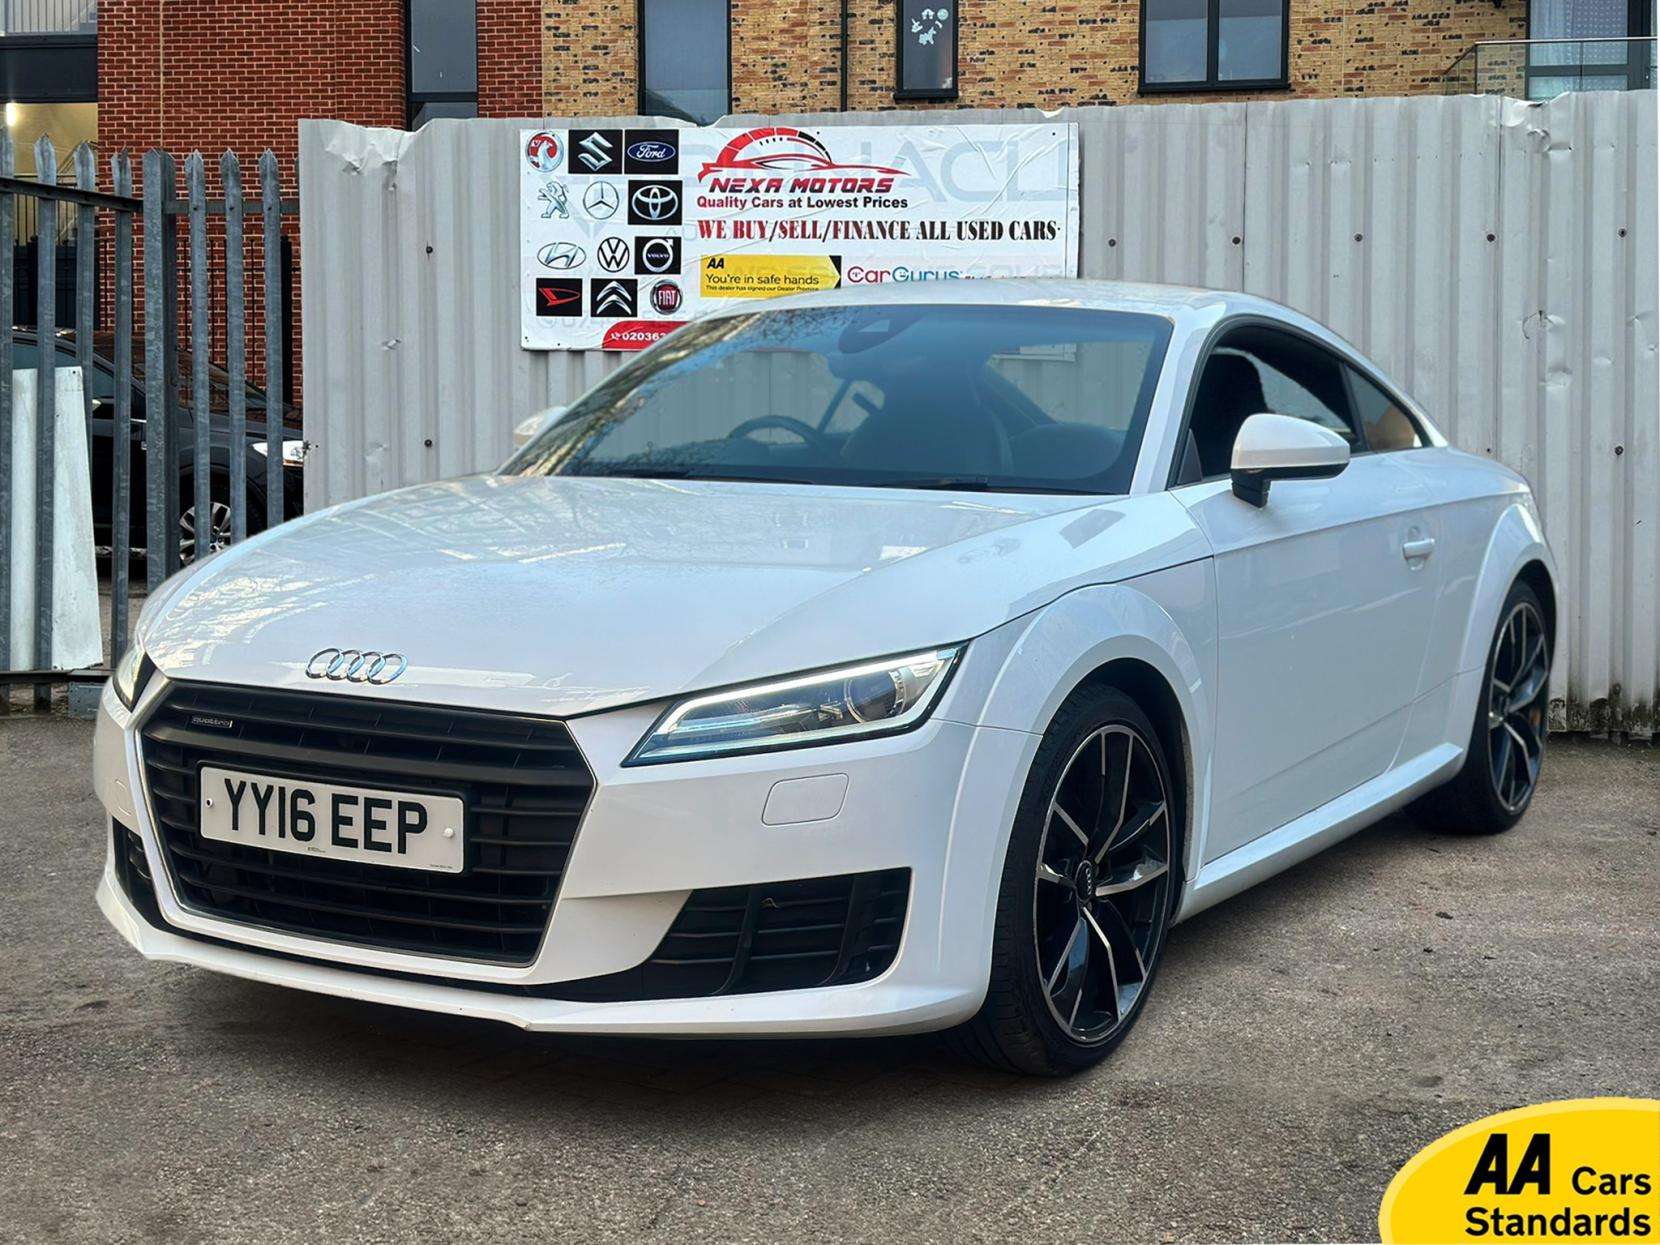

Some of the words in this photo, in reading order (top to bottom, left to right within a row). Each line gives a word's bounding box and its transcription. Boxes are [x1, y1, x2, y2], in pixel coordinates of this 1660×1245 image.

[636, 143, 666, 159] Ford
[709, 177, 784, 194] NEXA
[789, 177, 895, 194] MOTORS
[697, 195, 747, 210] Quality
[752, 196, 786, 208] Cars
[788, 197, 803, 208] at
[807, 196, 859, 208] Lowest
[862, 196, 909, 208] Prices
[697, 219, 727, 240] WE
[732, 219, 911, 242] BUY/SELL/FINANCE
[916, 220, 950, 240] ALL
[957, 220, 1004, 241] USED
[1008, 220, 1057, 241] CARS
[707, 257, 725, 269] AA
[706, 273, 741, 284] You're
[744, 274, 754, 284] in
[757, 274, 781, 284] safe
[784, 274, 820, 285] hands
[847, 266, 960, 283] CarGurus
[658, 289, 677, 306] FIAT
[224, 778, 316, 842] YY16
[331, 793, 428, 854] EEP
